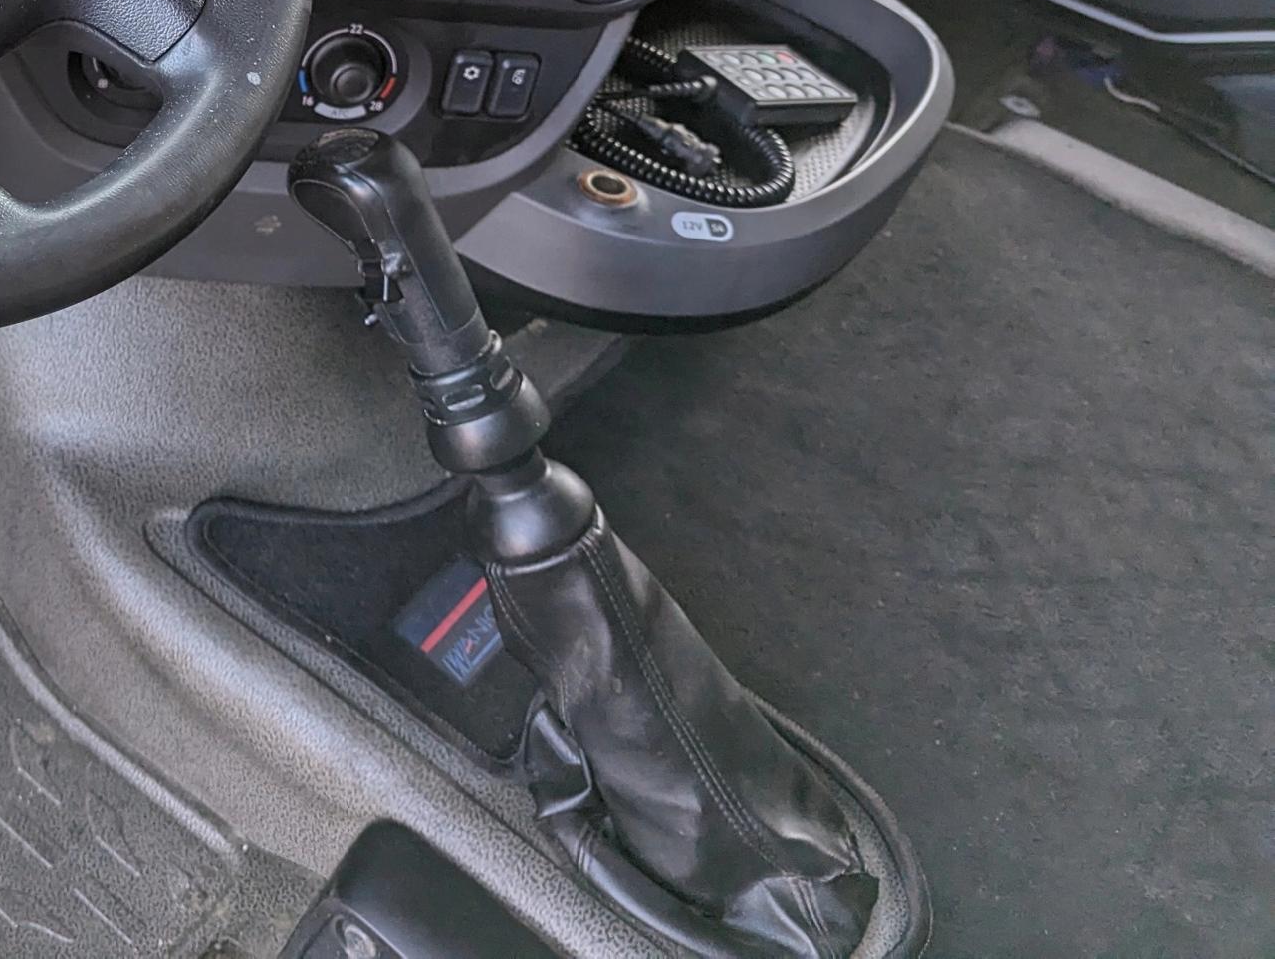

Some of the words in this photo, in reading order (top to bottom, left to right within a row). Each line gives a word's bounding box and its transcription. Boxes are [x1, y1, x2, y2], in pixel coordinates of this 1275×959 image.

[349, 24, 364, 35] 22
[302, 96, 314, 106] 16
[369, 101, 383, 111] 28
